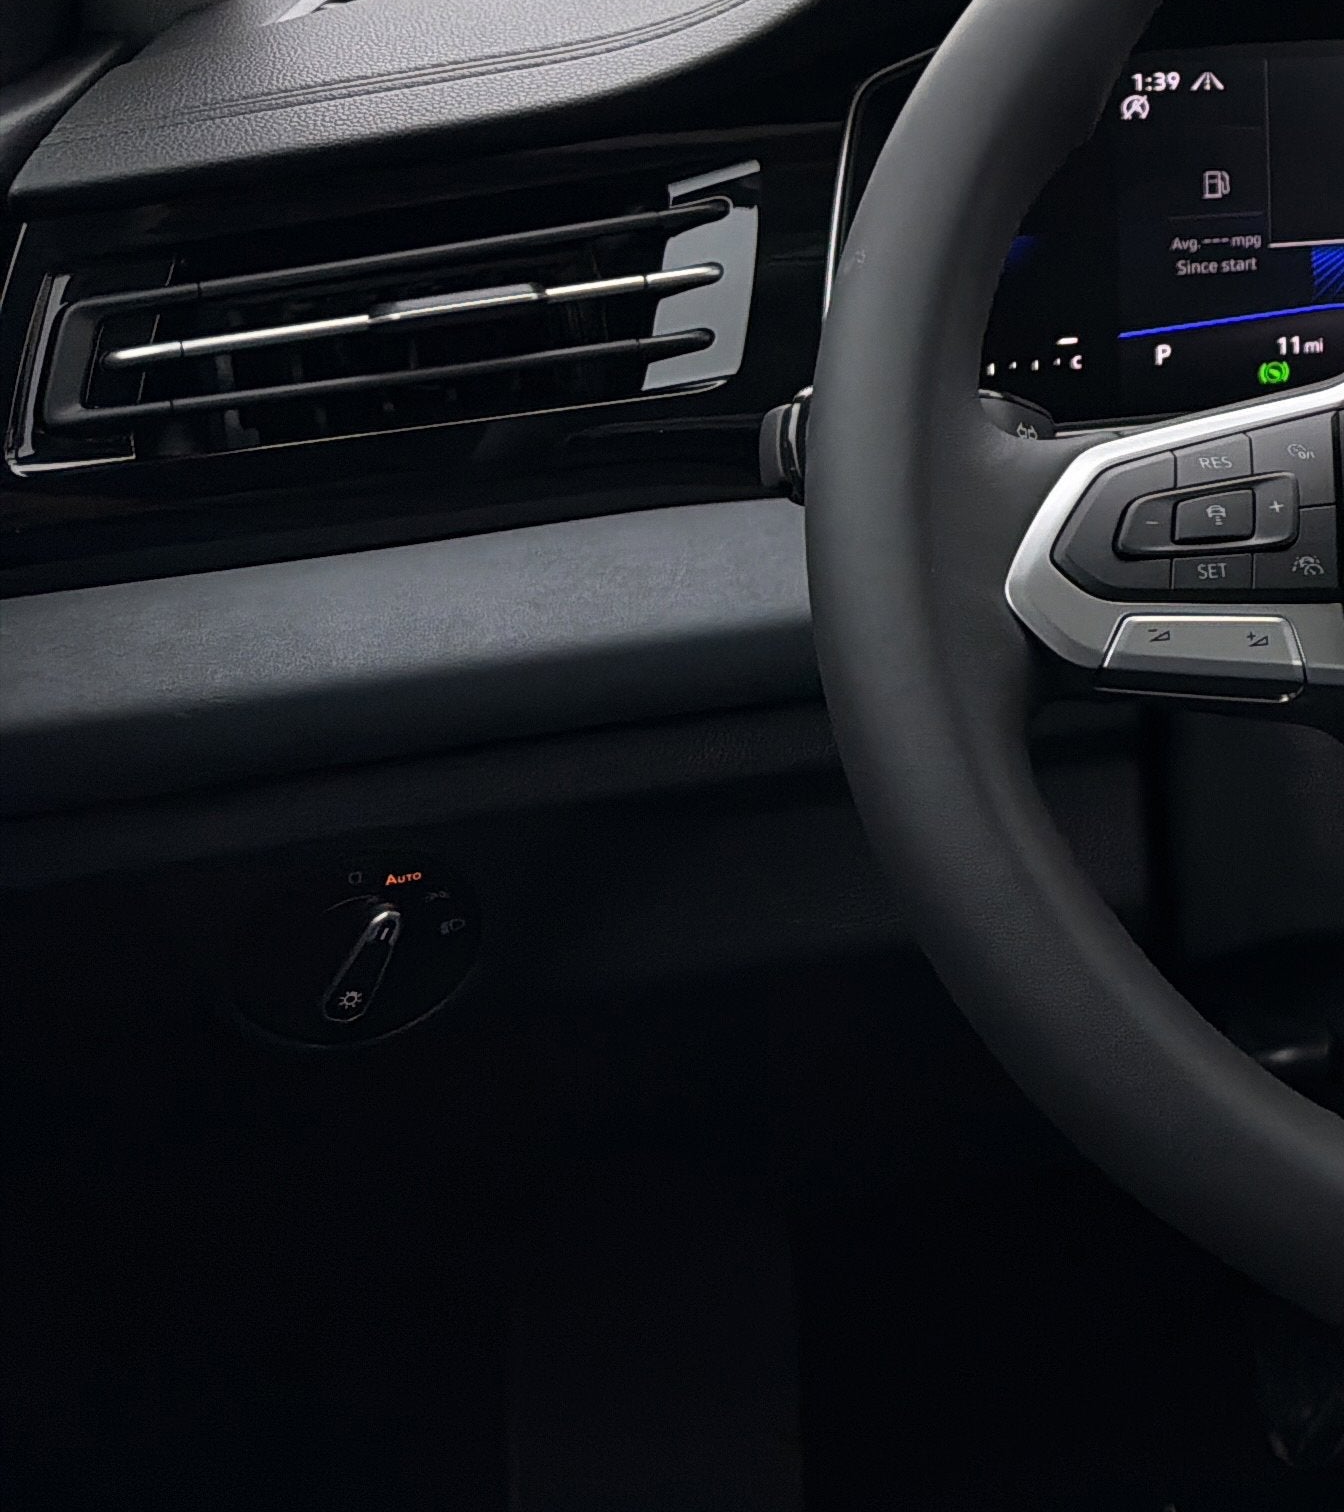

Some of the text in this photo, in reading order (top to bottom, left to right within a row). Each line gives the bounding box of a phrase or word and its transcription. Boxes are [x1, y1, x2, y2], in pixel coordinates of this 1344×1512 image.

[1131, 71, 1181, 92] 1:39
[1170, 237, 1201, 253] Avg.
[1231, 233, 1262, 249] mpg
[1176, 256, 1258, 276] Since start
[1154, 344, 1172, 366] P
[1276, 336, 1324, 356] 11 mi
[1199, 456, 1233, 470] RES
[1197, 562, 1228, 579] SET
